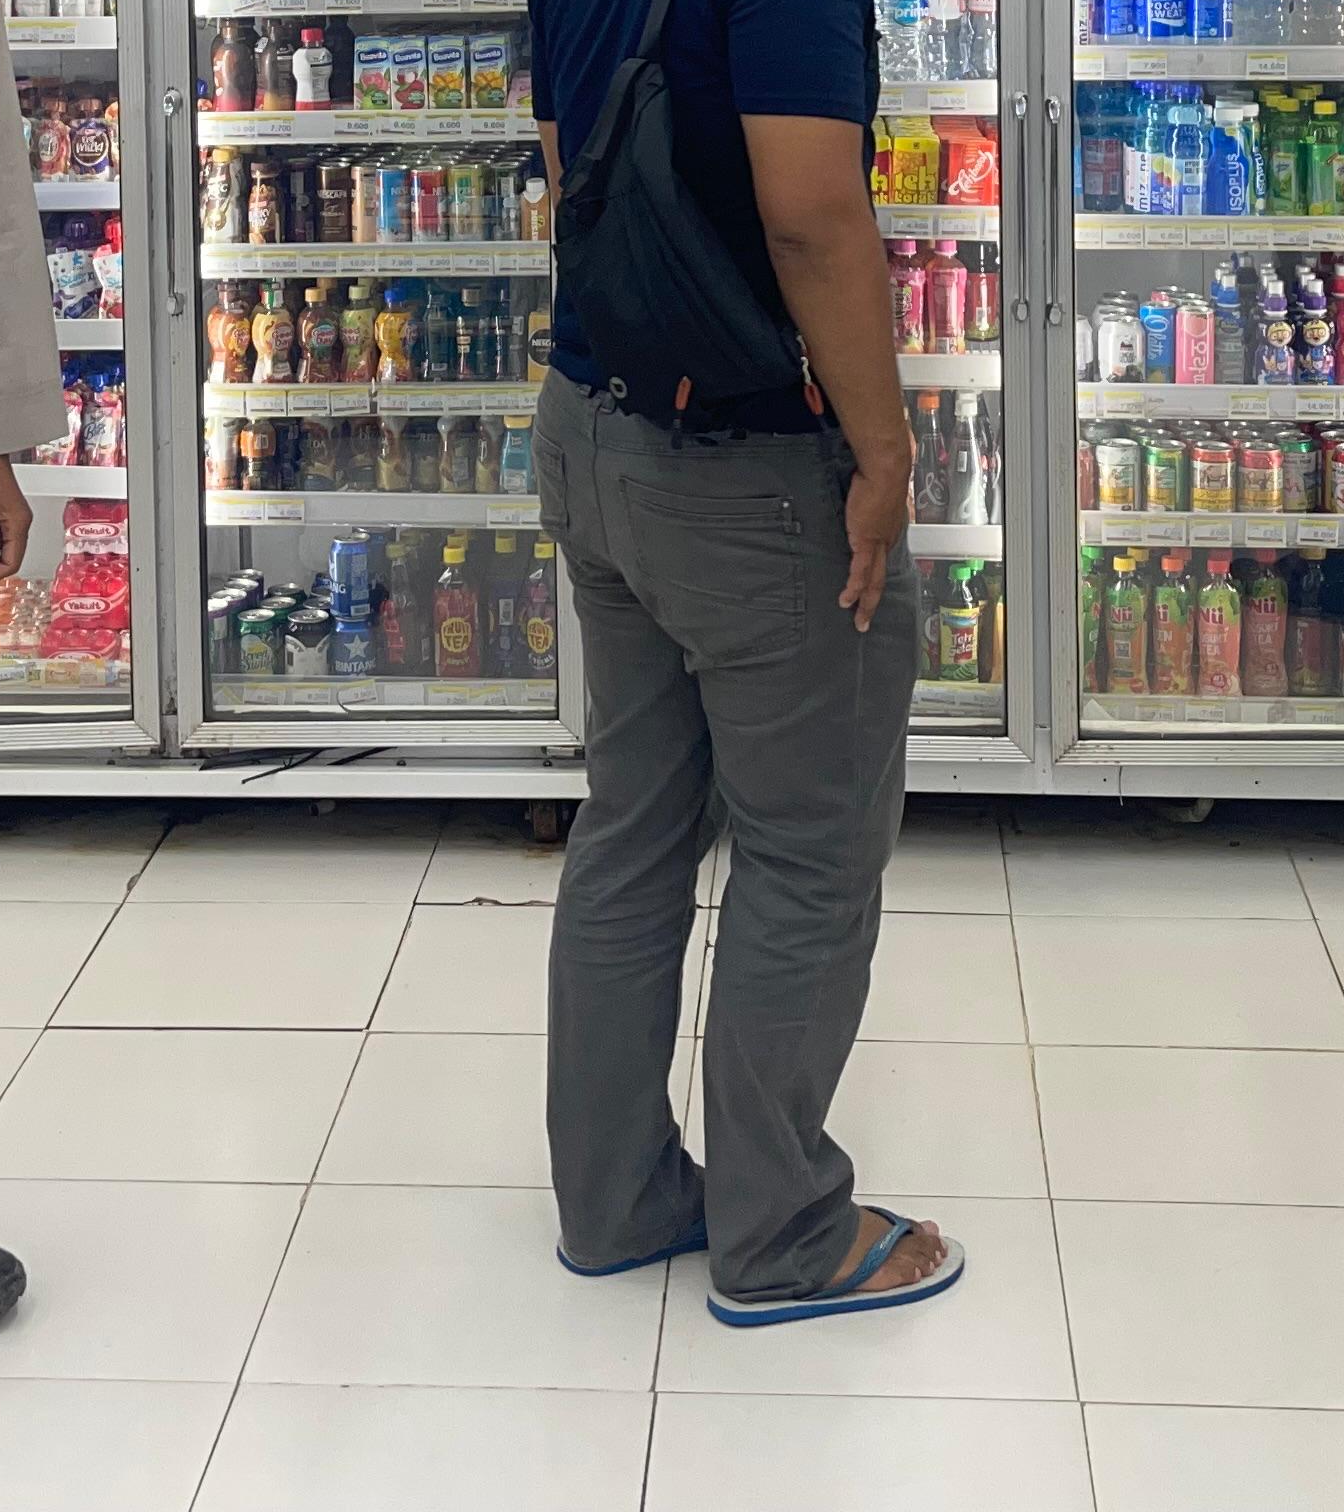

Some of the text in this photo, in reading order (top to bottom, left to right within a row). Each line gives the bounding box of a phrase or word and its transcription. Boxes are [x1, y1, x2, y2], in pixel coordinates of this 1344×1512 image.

[1228, 153, 1243, 212] ISOPLUS
[78, 526, 110, 536] Yakult
[68, 601, 101, 611] Yakult
